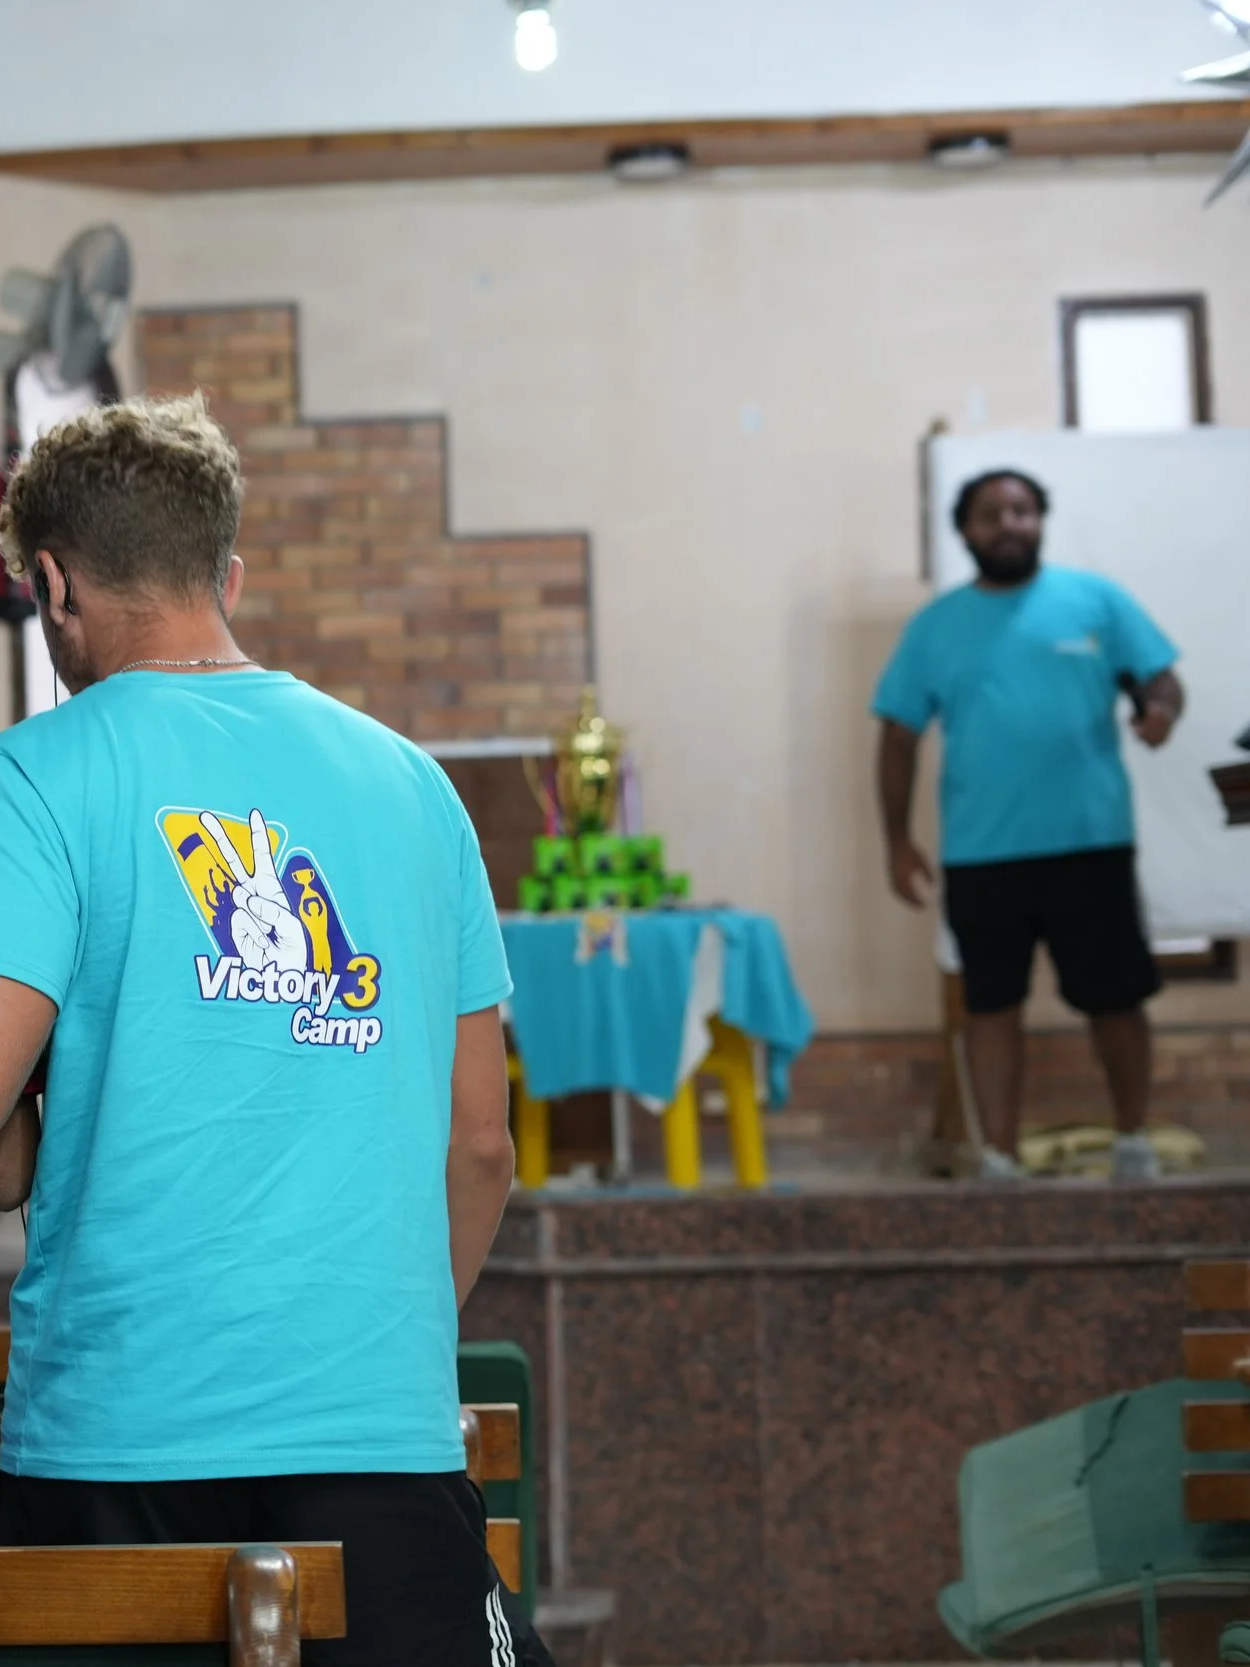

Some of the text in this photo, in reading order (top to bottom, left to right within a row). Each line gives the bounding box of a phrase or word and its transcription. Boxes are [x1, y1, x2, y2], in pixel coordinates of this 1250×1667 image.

[195, 954, 381, 1016] Victory 3
[291, 1007, 382, 1053] Camp
